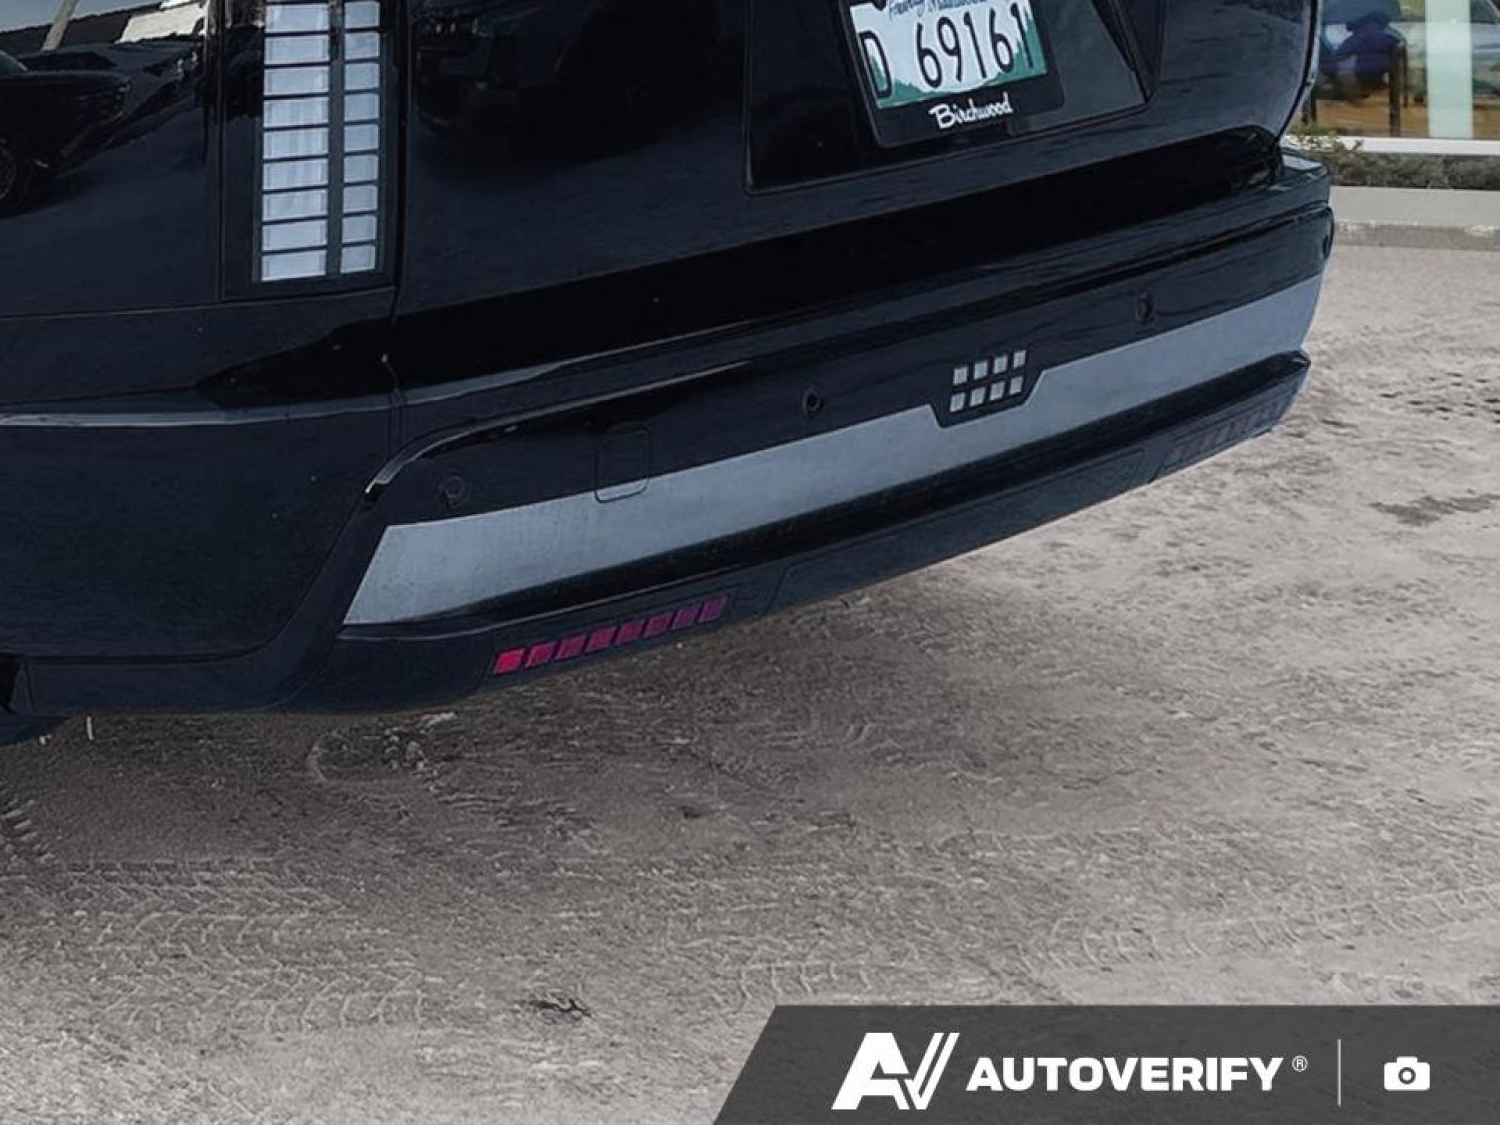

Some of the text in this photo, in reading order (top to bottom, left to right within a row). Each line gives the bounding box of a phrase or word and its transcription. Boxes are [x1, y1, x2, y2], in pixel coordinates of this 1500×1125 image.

[857, 30, 892, 99] D
[915, 2, 1034, 89] 69161
[928, 91, 1014, 129] Birchwood
